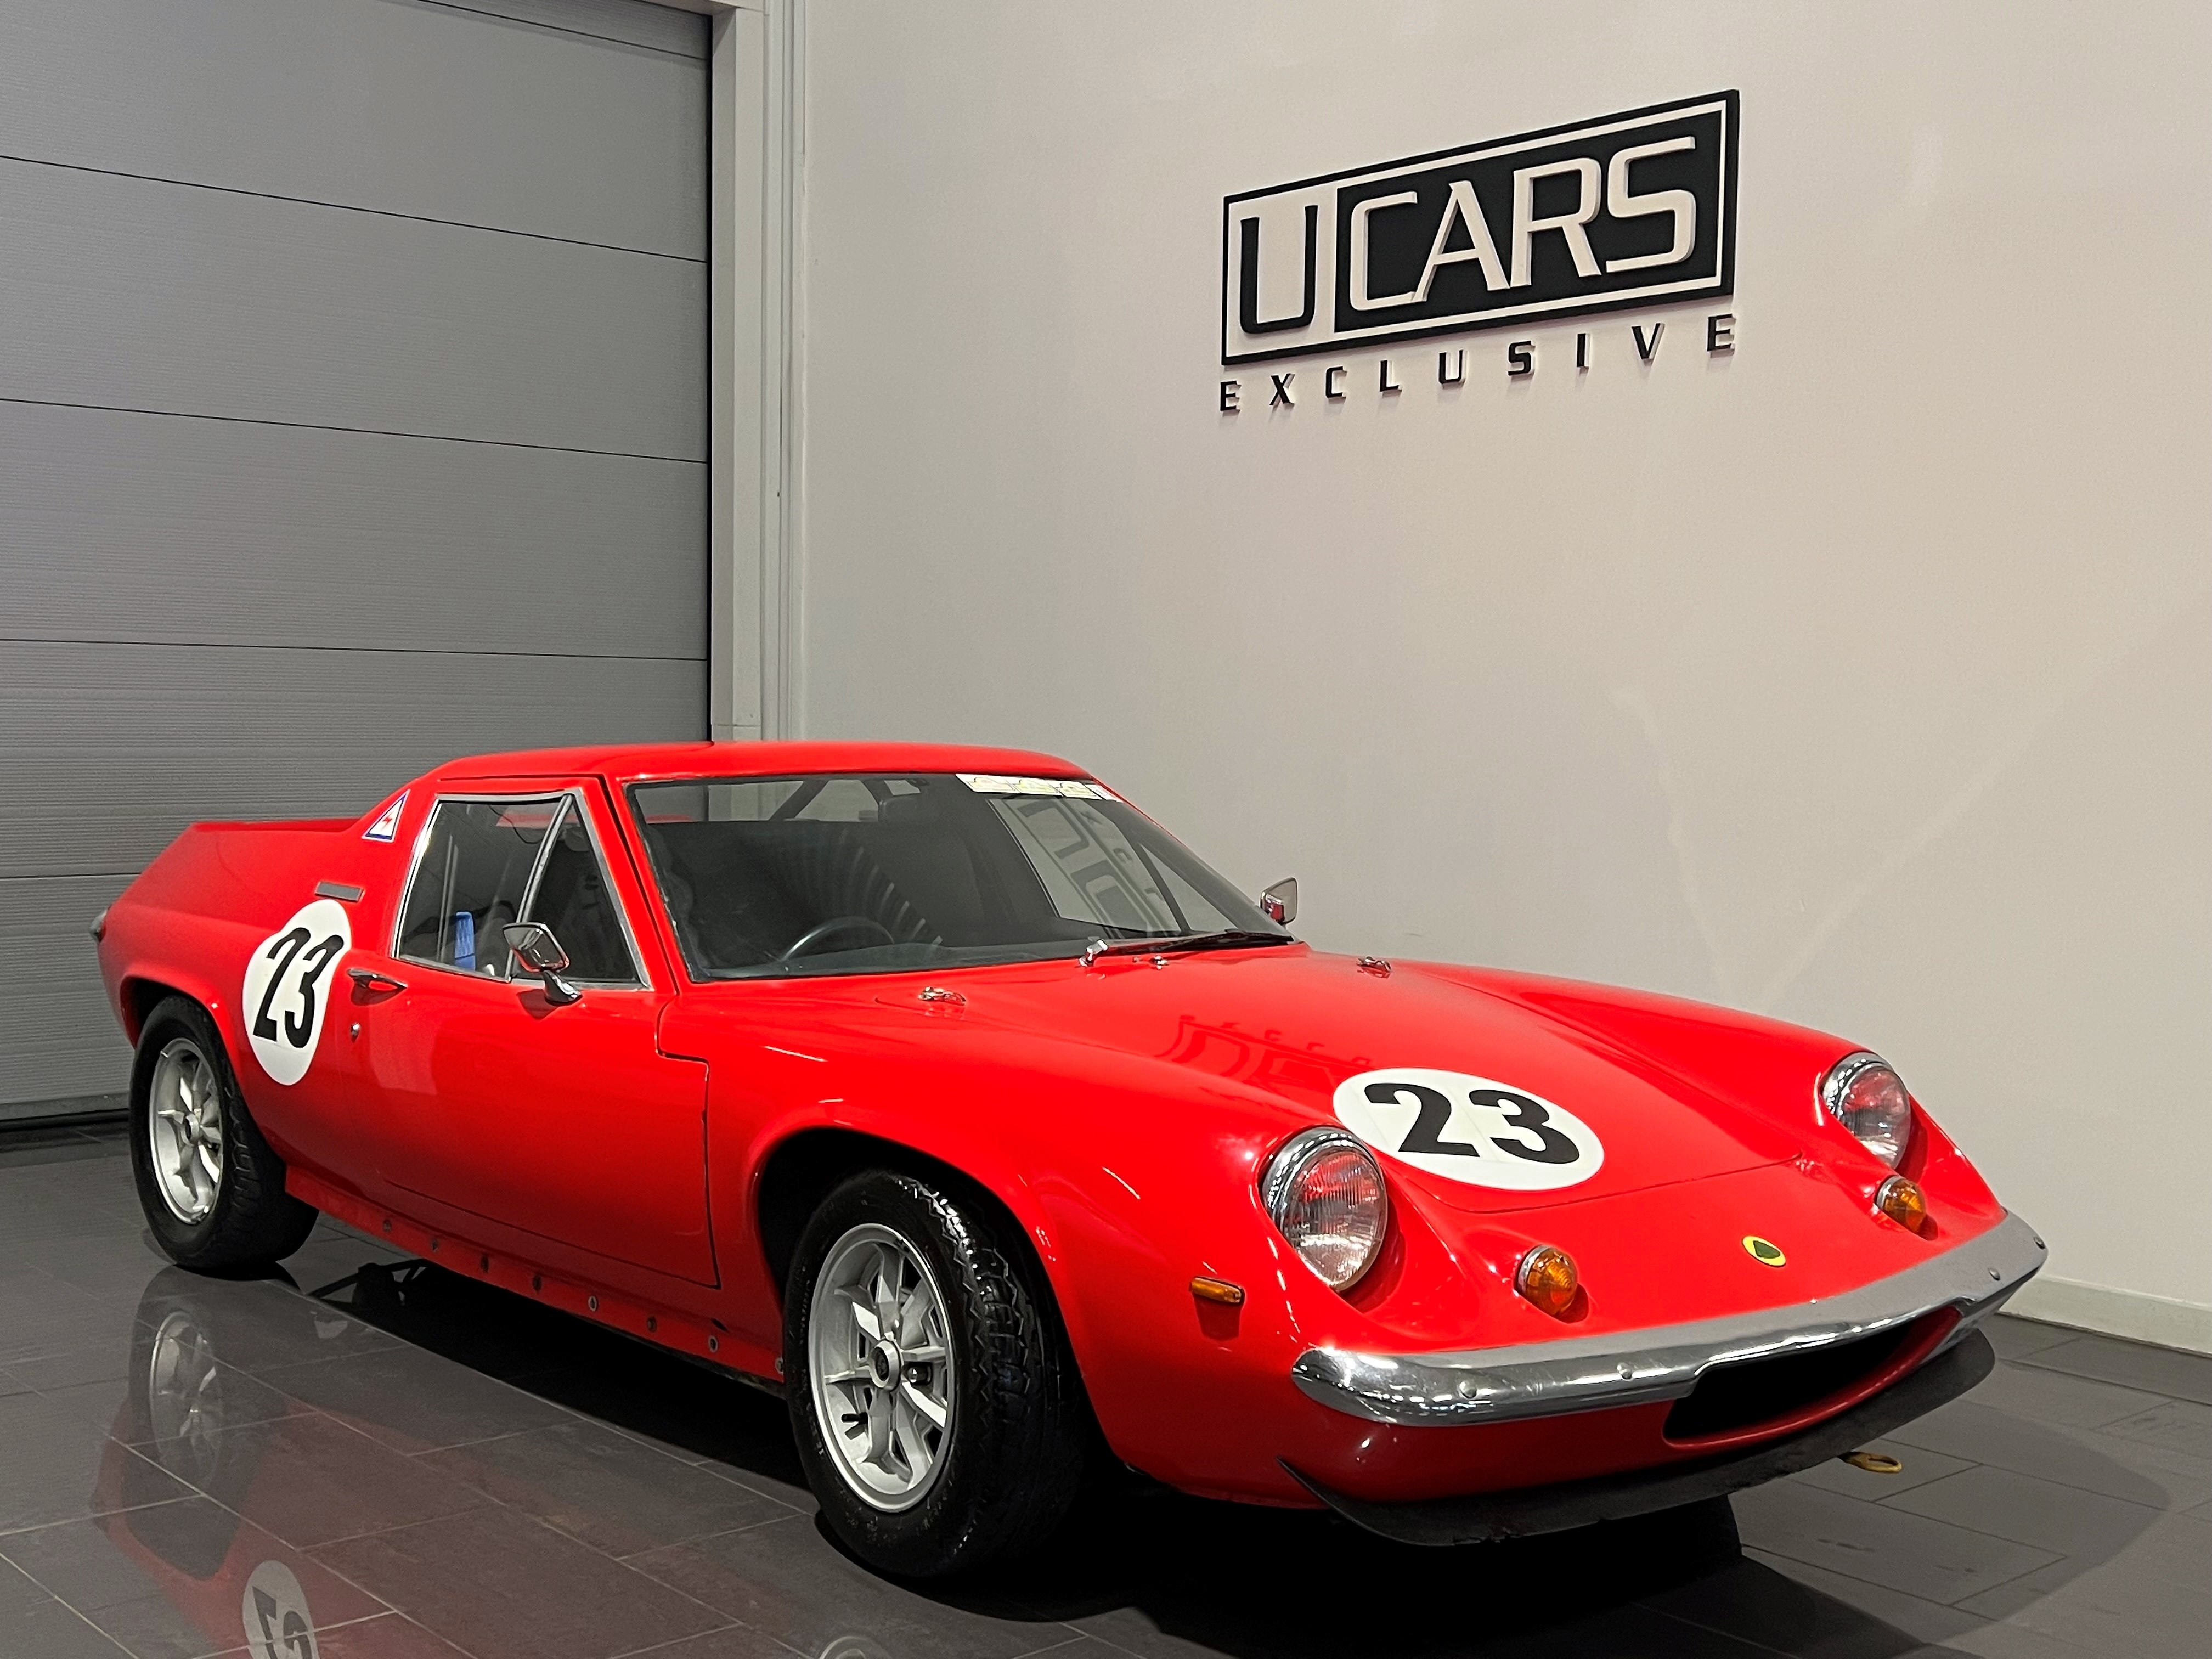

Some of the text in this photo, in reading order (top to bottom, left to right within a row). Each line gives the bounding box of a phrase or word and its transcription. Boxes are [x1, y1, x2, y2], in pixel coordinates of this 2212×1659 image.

[1219, 313, 1735, 411] EXCLUSIVE
[253, 927, 345, 1049] 23
[1364, 1082, 1579, 1164] 23
